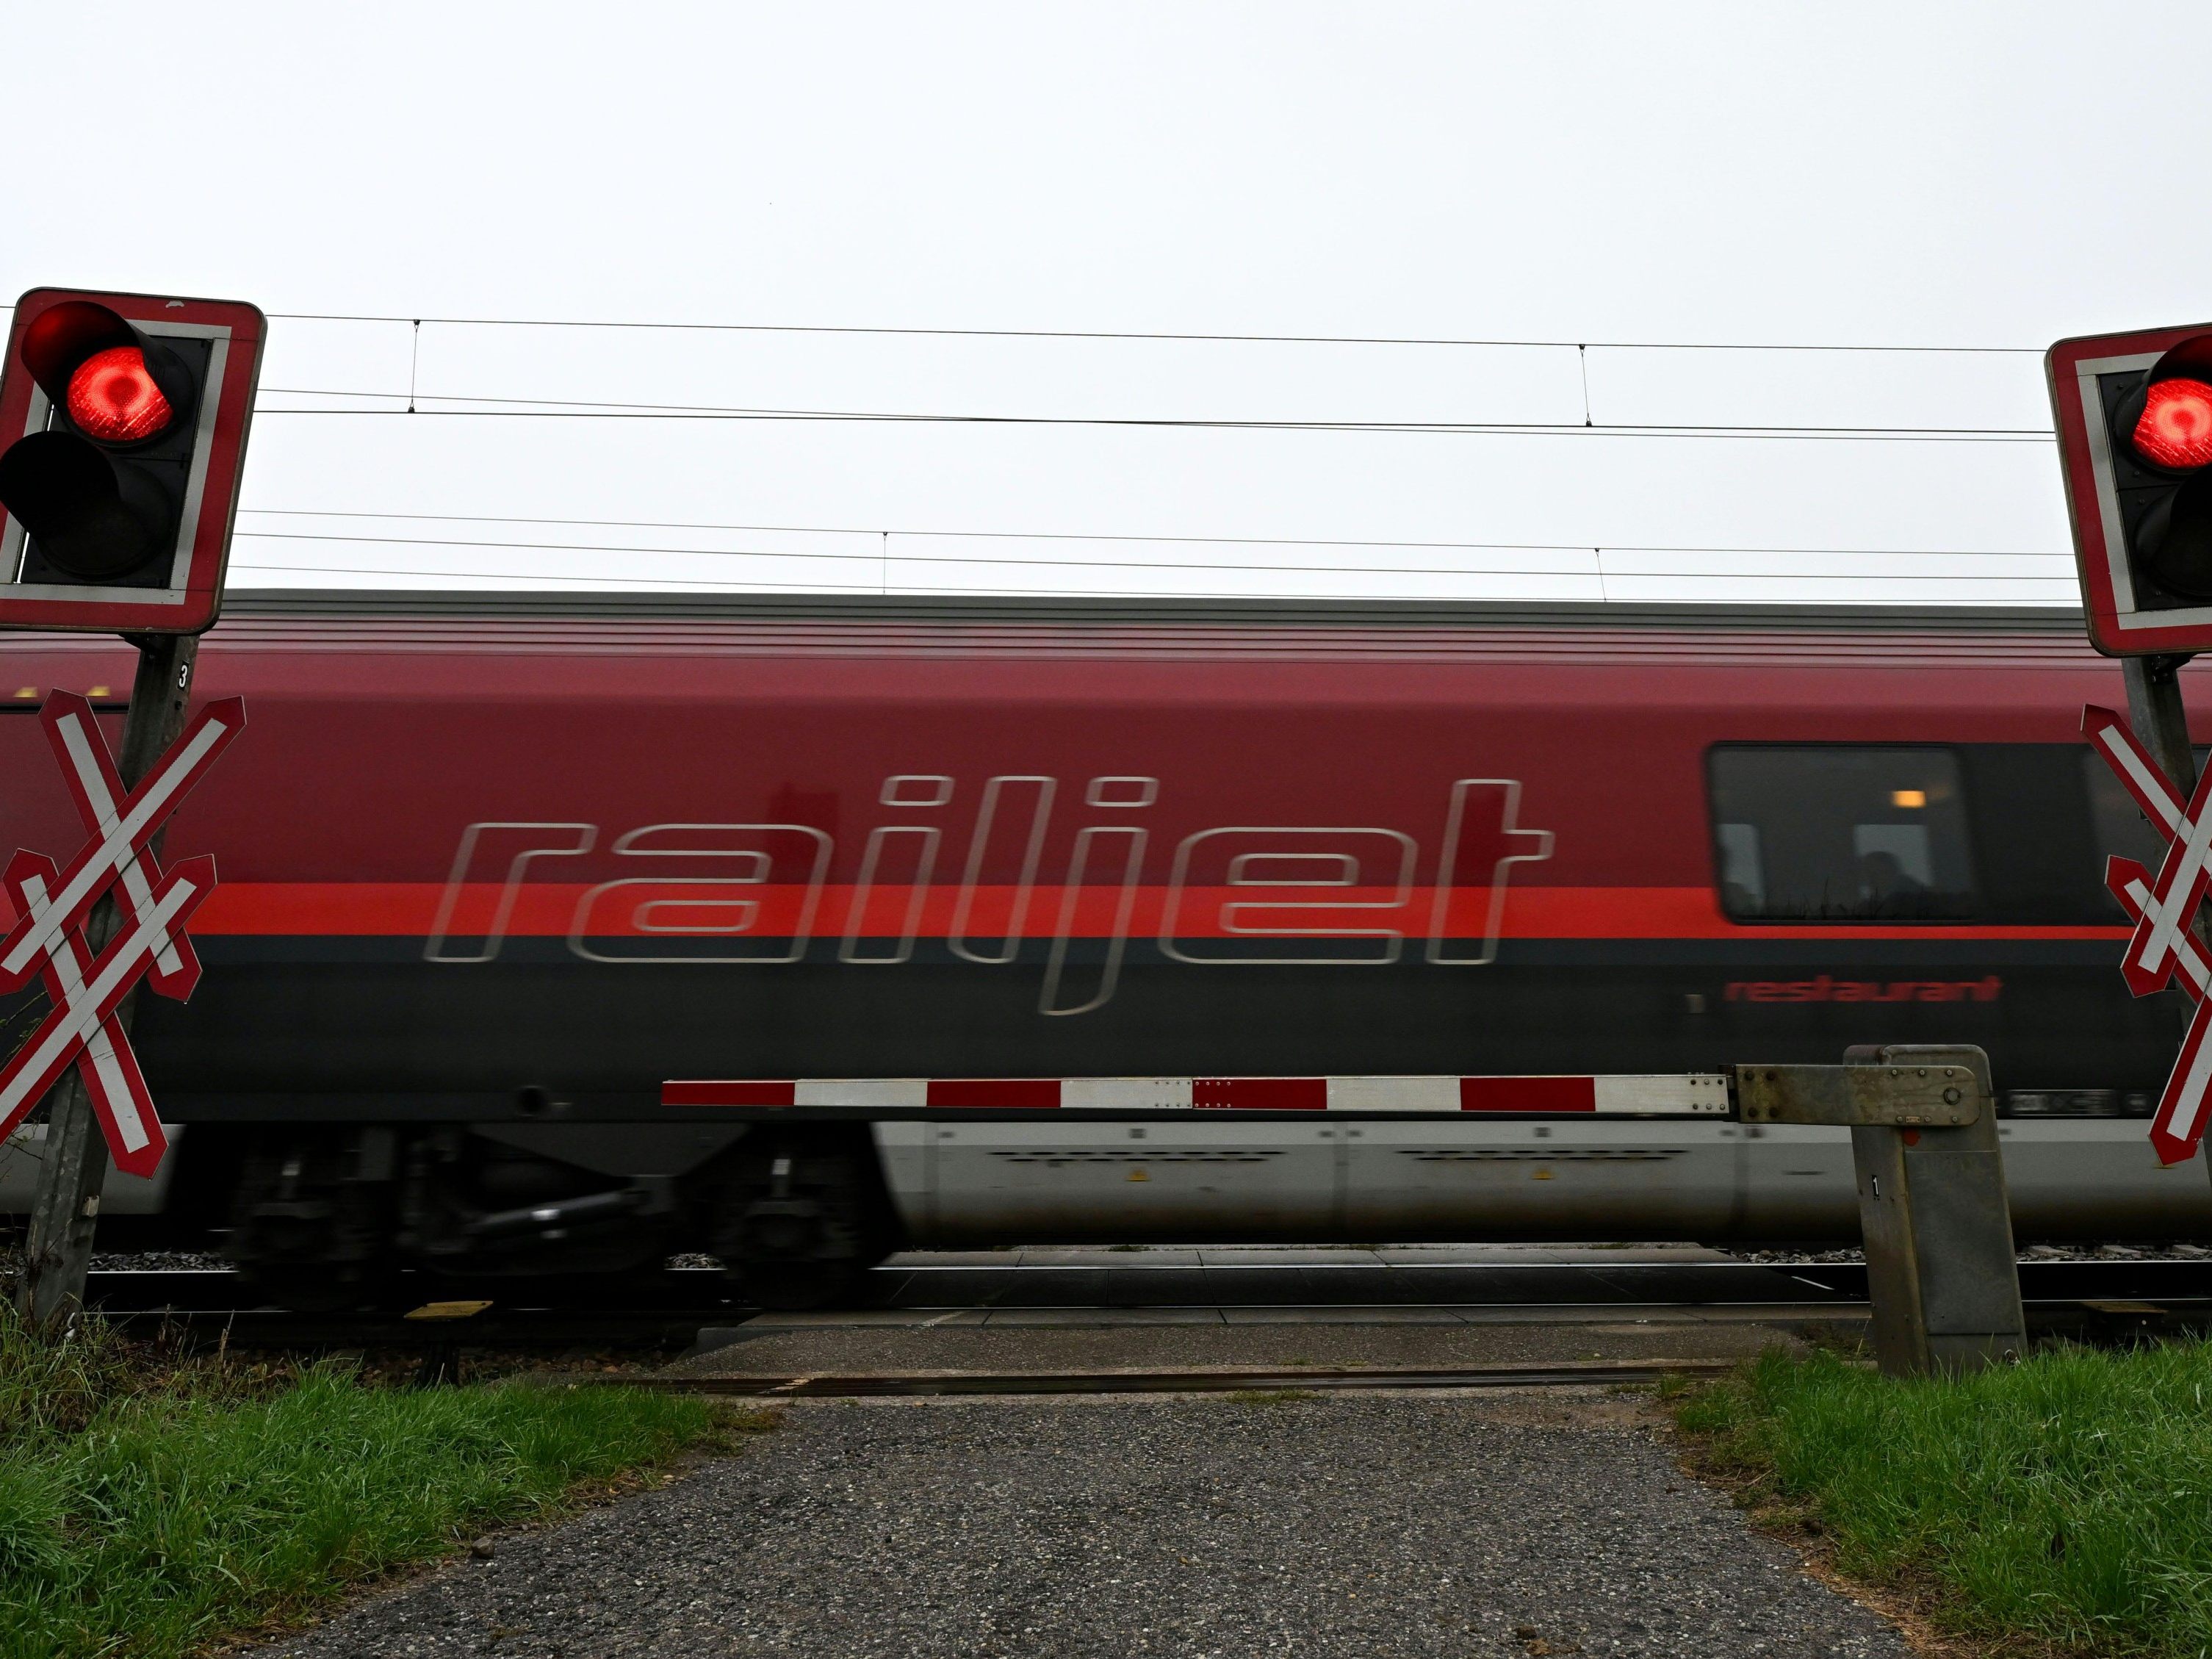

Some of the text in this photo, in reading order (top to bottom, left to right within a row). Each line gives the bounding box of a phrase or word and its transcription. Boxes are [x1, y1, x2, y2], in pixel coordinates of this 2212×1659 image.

[179, 664, 188, 688] 3
[423, 775, 1554, 1015] railjet
[1723, 974, 2003, 1002] restaurant
